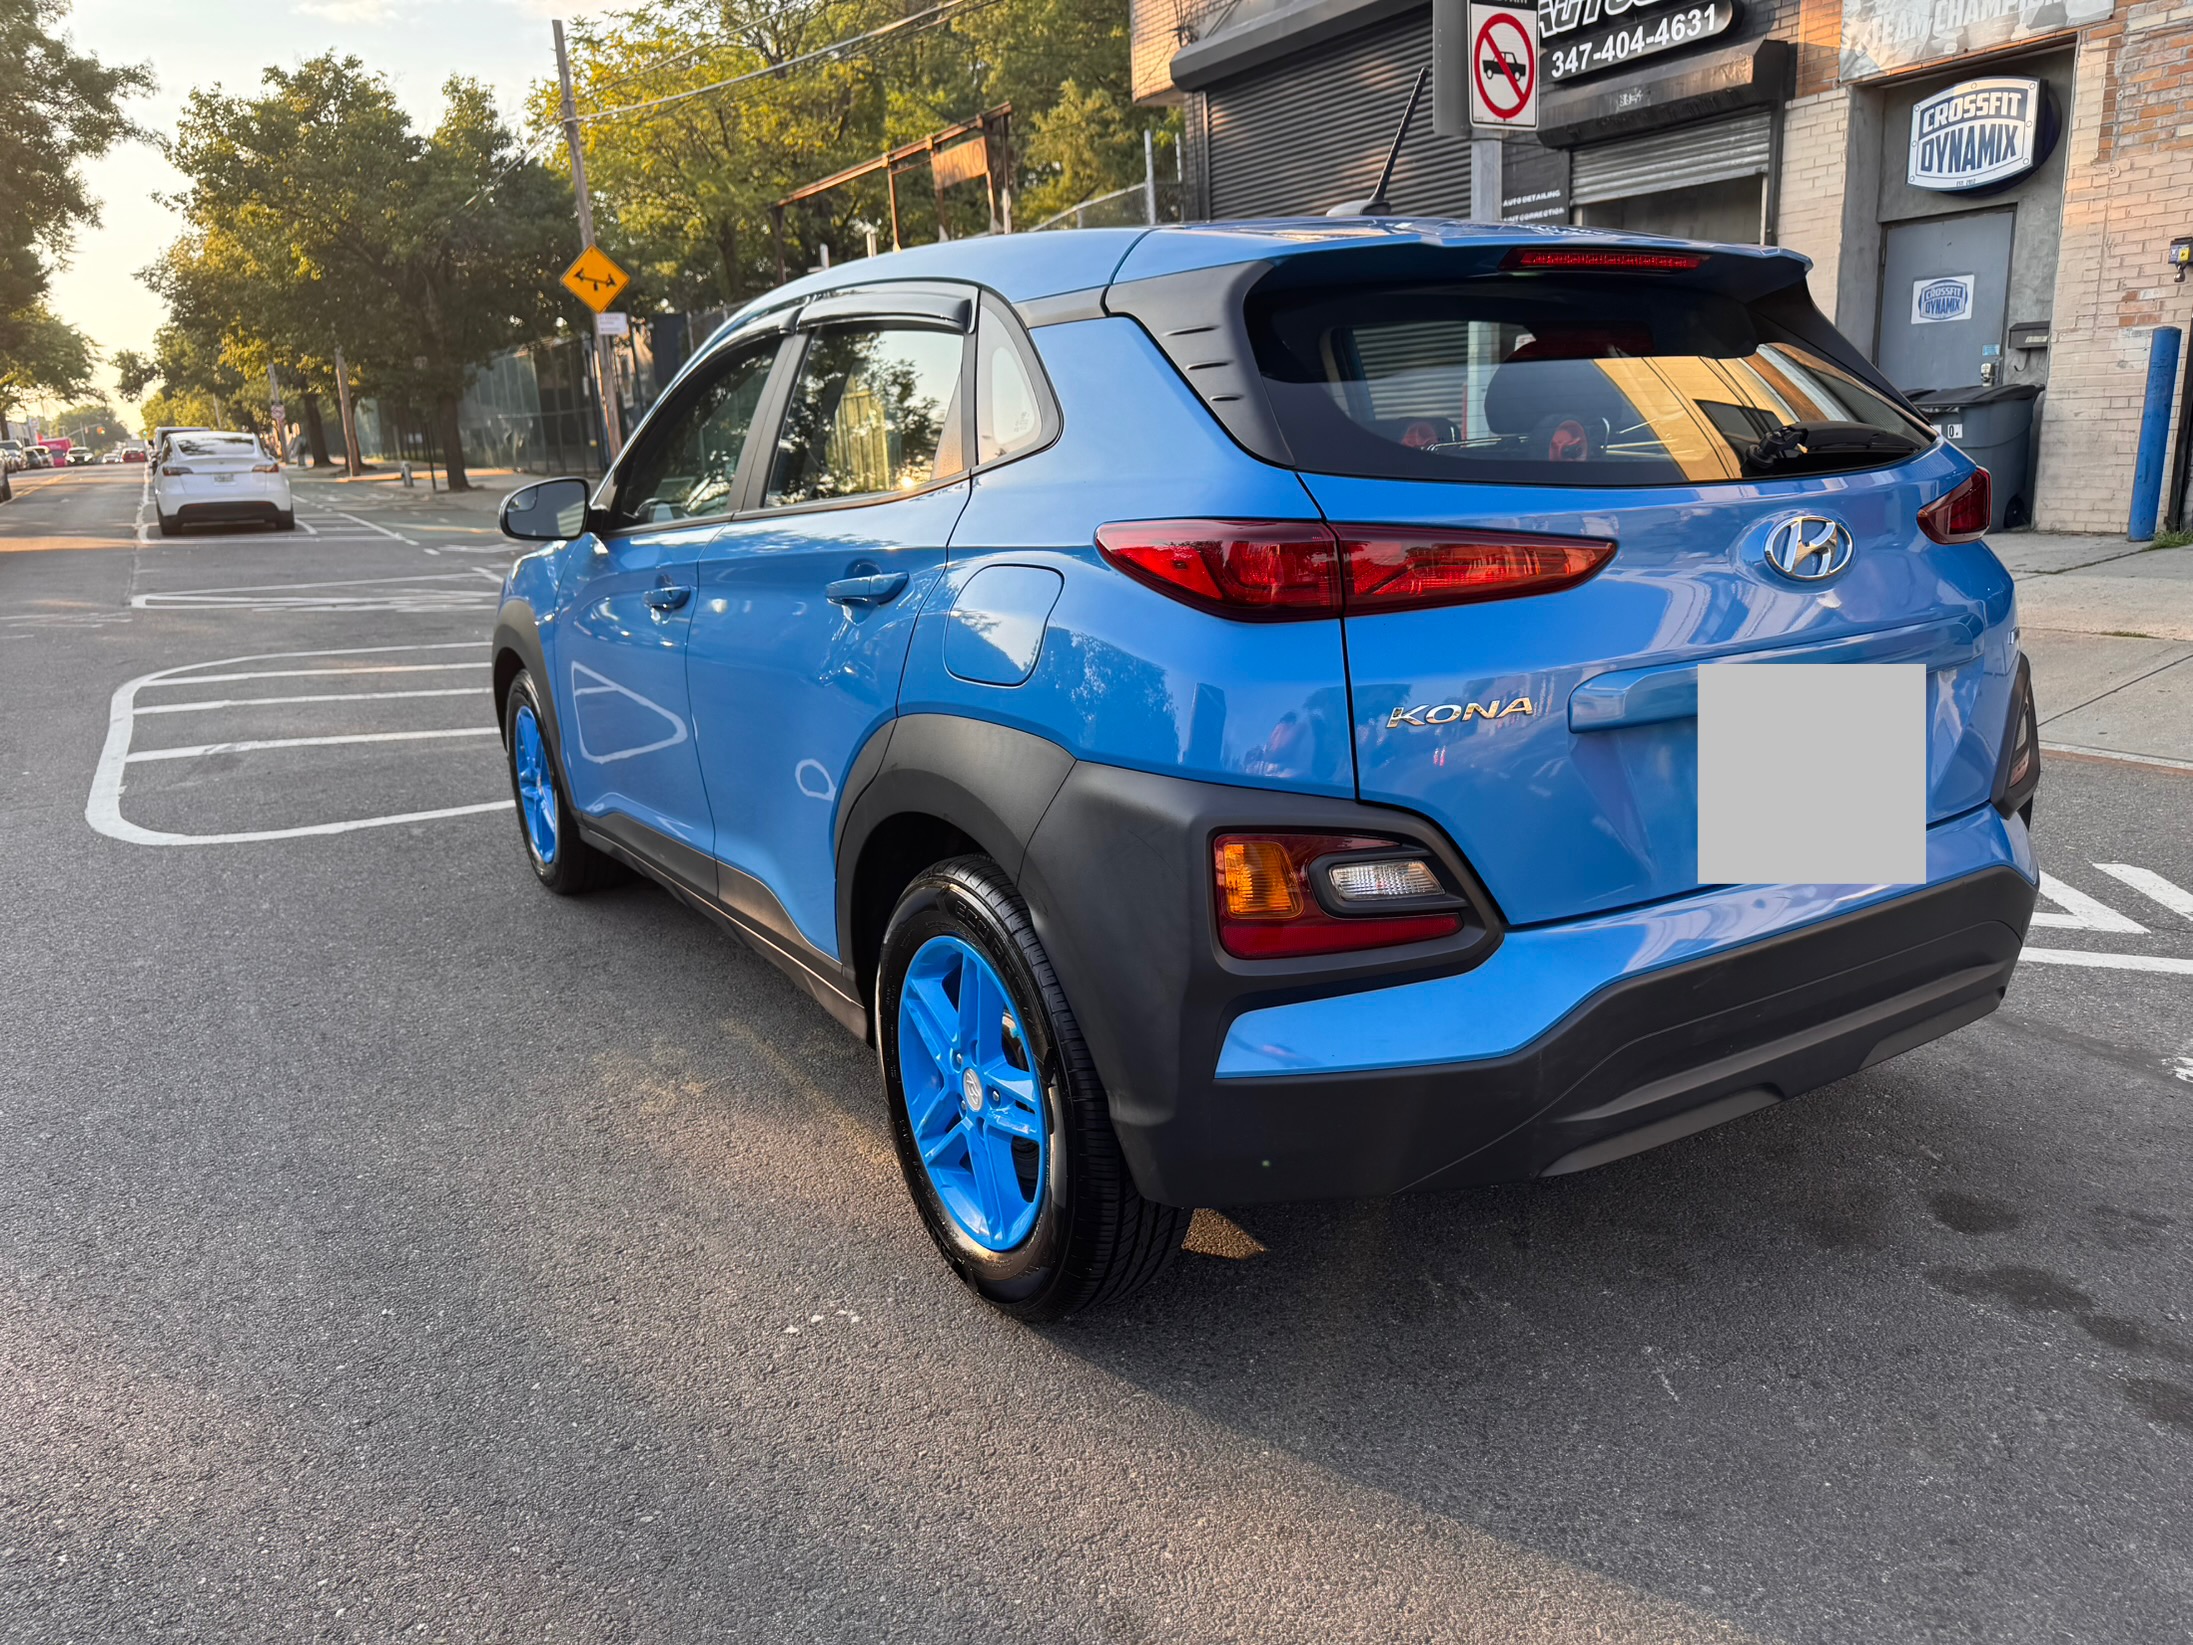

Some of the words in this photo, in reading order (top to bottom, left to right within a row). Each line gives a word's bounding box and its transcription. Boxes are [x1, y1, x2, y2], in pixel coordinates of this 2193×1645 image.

[1551, 3, 1716, 78] 347-404-4631
[1922, 91, 2022, 134] CROSSFIT
[1920, 123, 2018, 174] DYNAMIX
[1502, 196, 1522, 207] AUTO
[1522, 189, 1561, 203] DETAILING
[1925, 286, 1962, 299] CROSSFIT
[1925, 297, 1961, 315] DYNAMIX
[1385, 697, 1534, 729] KONA
